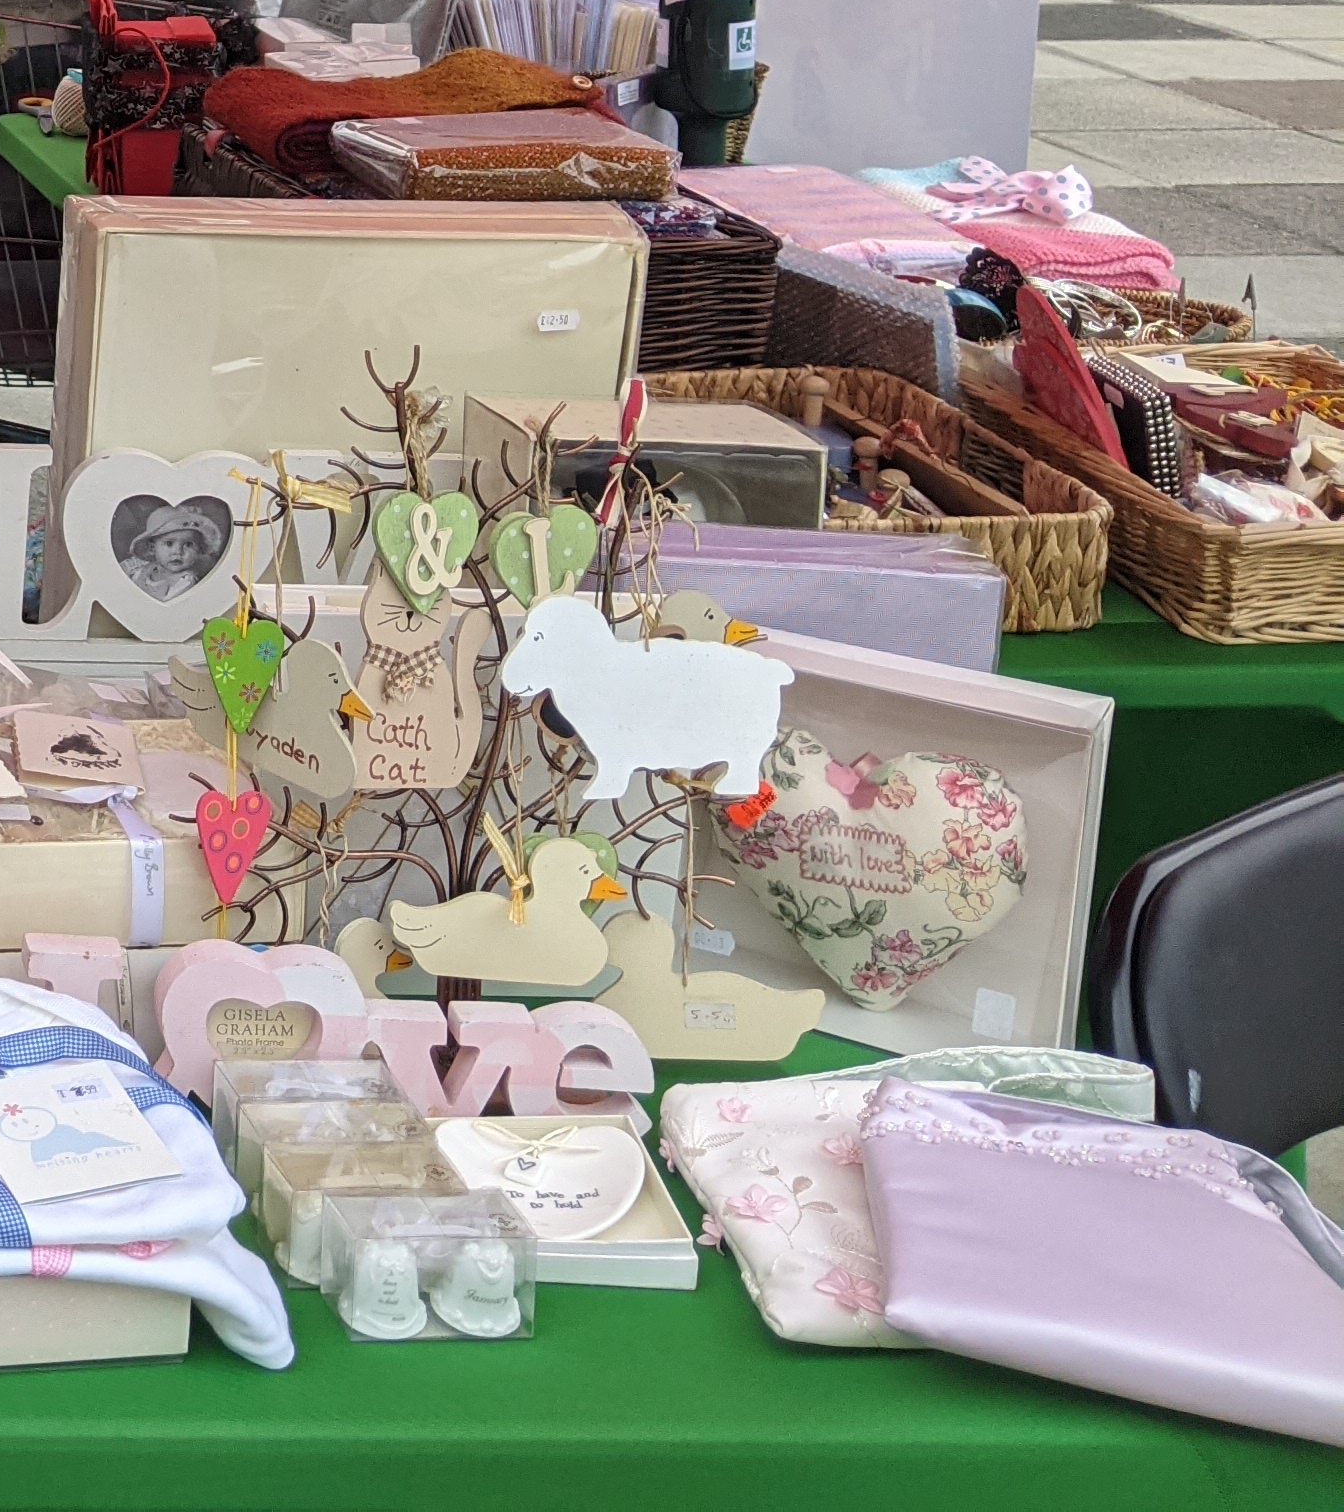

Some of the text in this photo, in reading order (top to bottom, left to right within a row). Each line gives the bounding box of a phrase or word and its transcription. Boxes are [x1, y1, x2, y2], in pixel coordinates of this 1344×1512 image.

[367, 711, 432, 751] Cath
[369, 754, 427, 785] Cat
[811, 842, 900, 873] with love
[144, 863, 159, 896] Brown
[224, 1008, 286, 1022] GISELA
[216, 1023, 295, 1037] GRAHAM
[226, 1038, 285, 1047] Photo Frame
[35, 1145, 143, 1170] melting hearts
[506, 1188, 600, 1200] To have and
[529, 1199, 583, 1210] to hold
[462, 1288, 510, 1306] January
